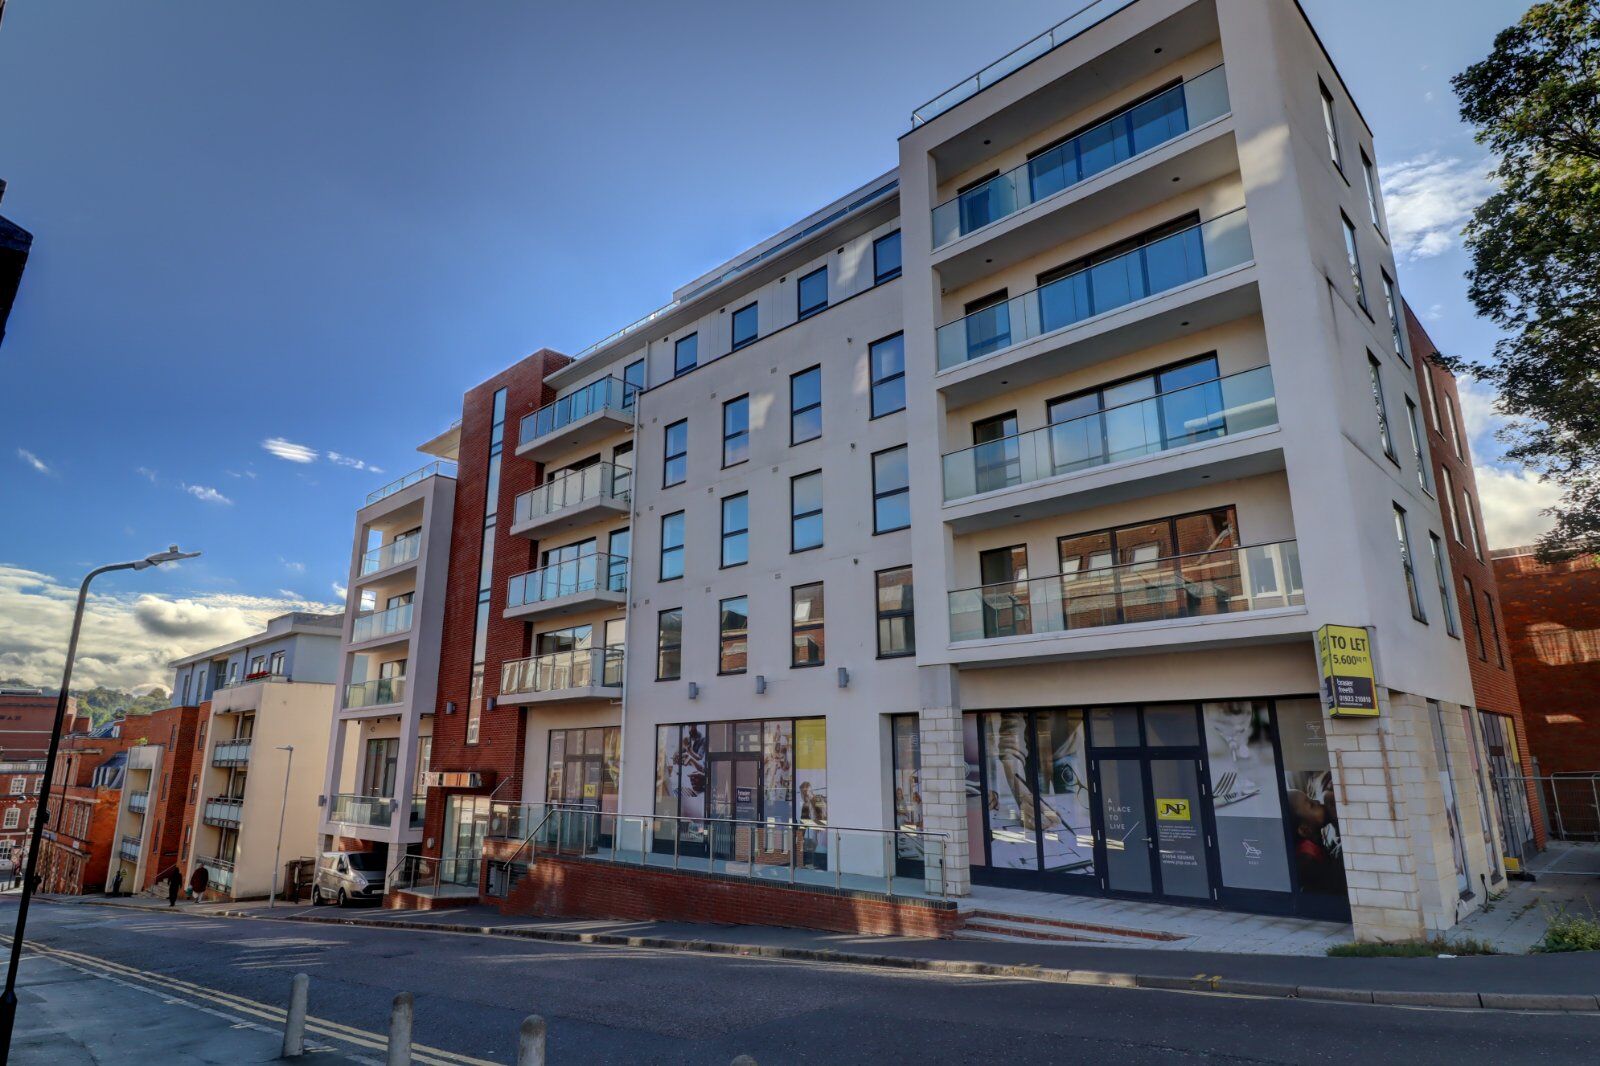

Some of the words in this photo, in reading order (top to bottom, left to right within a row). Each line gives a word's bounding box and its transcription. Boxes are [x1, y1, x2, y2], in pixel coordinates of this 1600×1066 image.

[1330, 635, 1346, 649] TO
[1350, 637, 1366, 651] LET
[1333, 654, 1357, 665] 5,600
[1160, 803, 1186, 815] JNP
